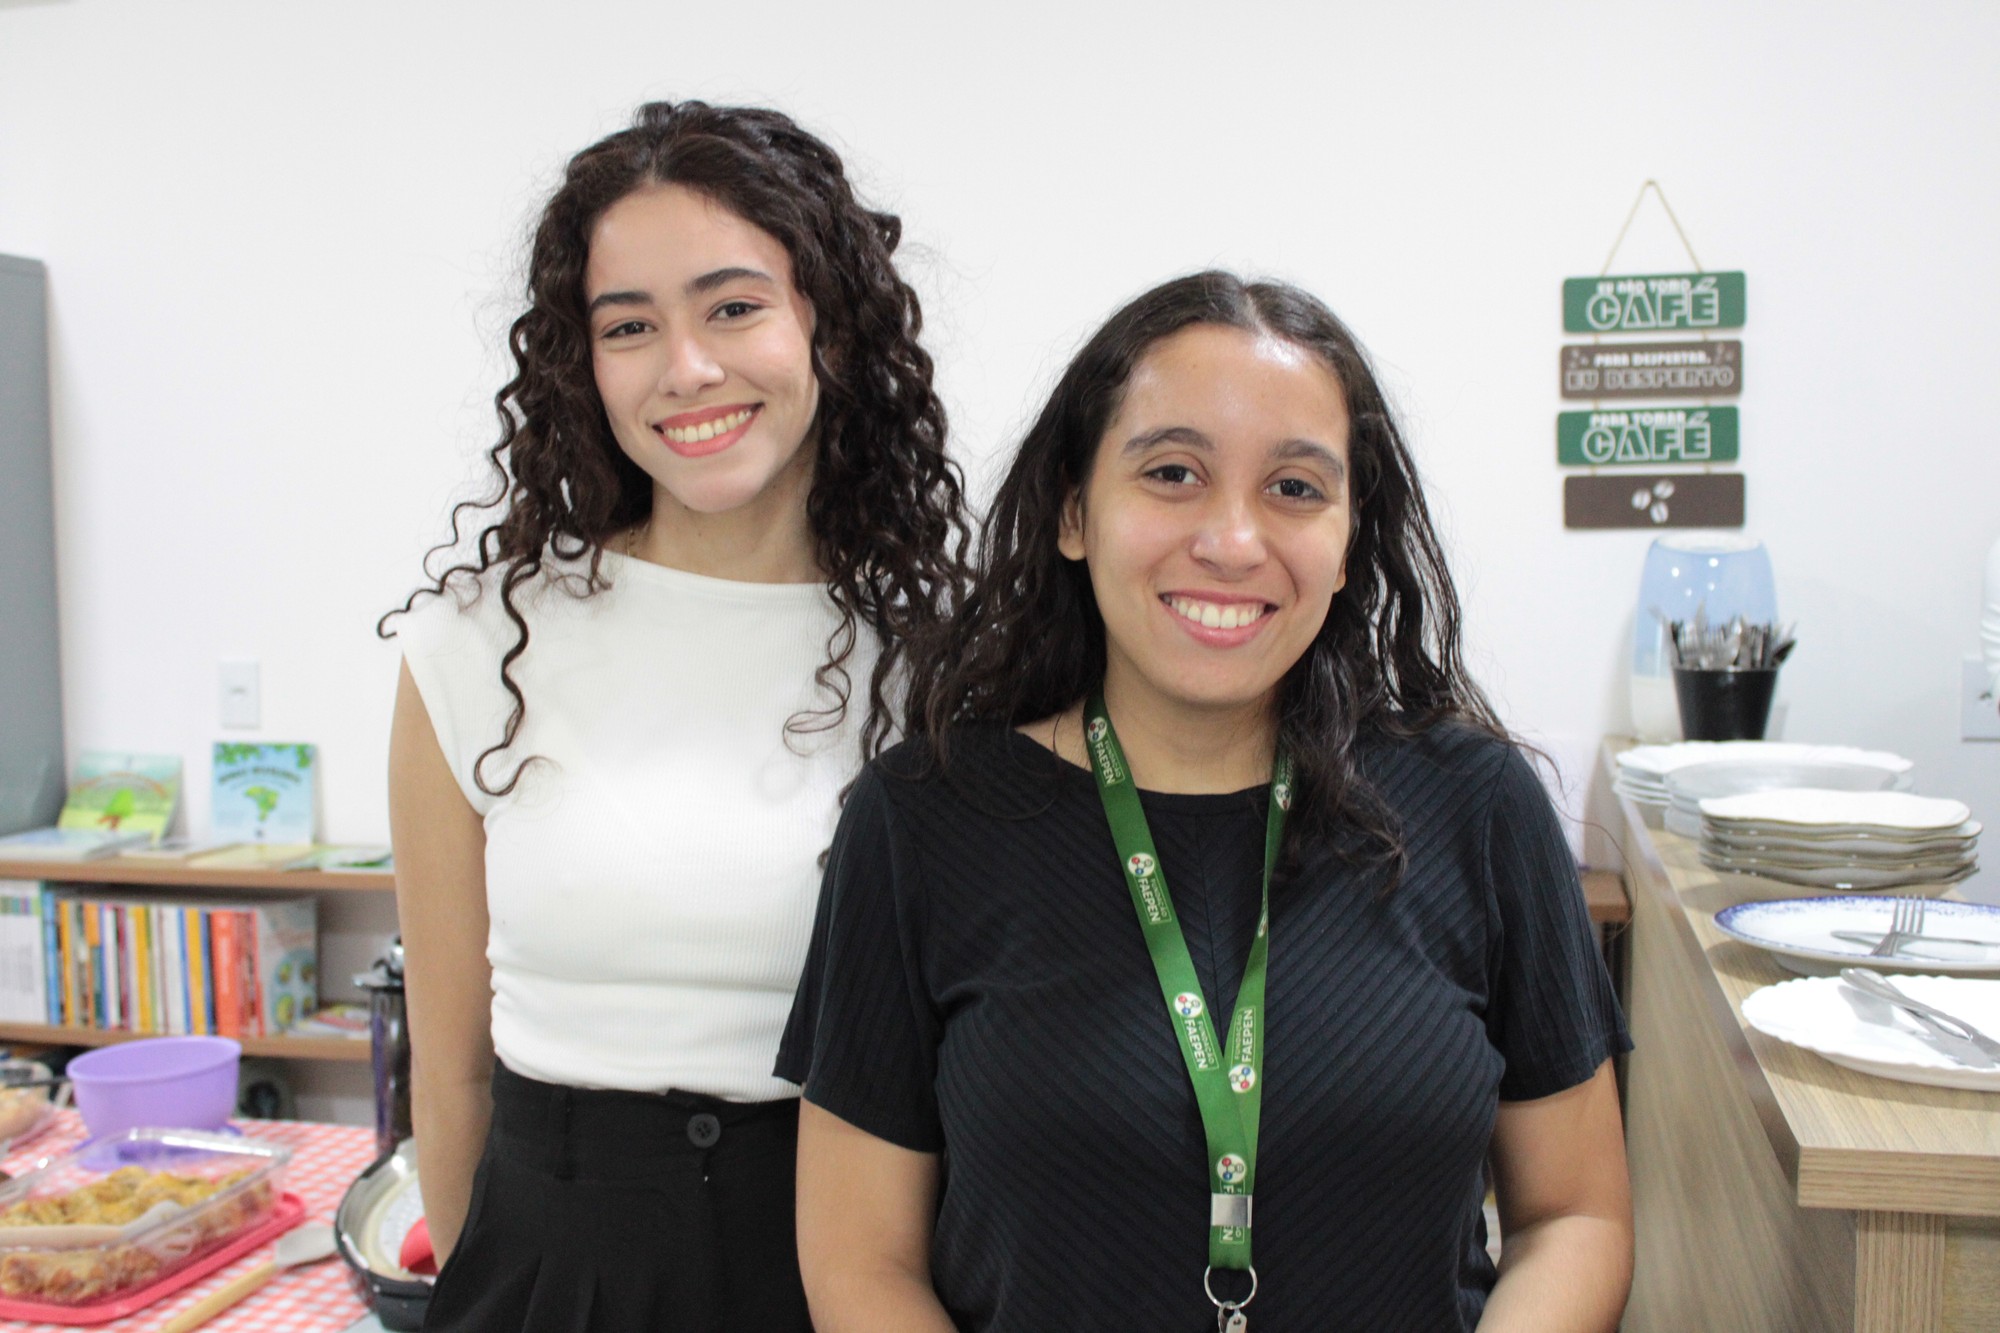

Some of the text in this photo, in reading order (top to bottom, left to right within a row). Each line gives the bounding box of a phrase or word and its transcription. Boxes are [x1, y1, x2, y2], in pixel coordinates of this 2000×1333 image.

[1586, 278, 1719, 330] CAFÉ
[1649, 278, 1691, 293] TOMO
[1565, 366, 1735, 391] EU DESPERTO
[1594, 353, 1629, 367] PARA
[1581, 411, 1711, 463] CAFÉ
[1590, 411, 1686, 428] PARA TOMAR
[1095, 741, 1116, 785] FAEPEN
[1138, 878, 1161, 922] FAEPEN
[1184, 1018, 1208, 1069] FAEPEN
[1241, 1008, 1253, 1063] FAEPEN
